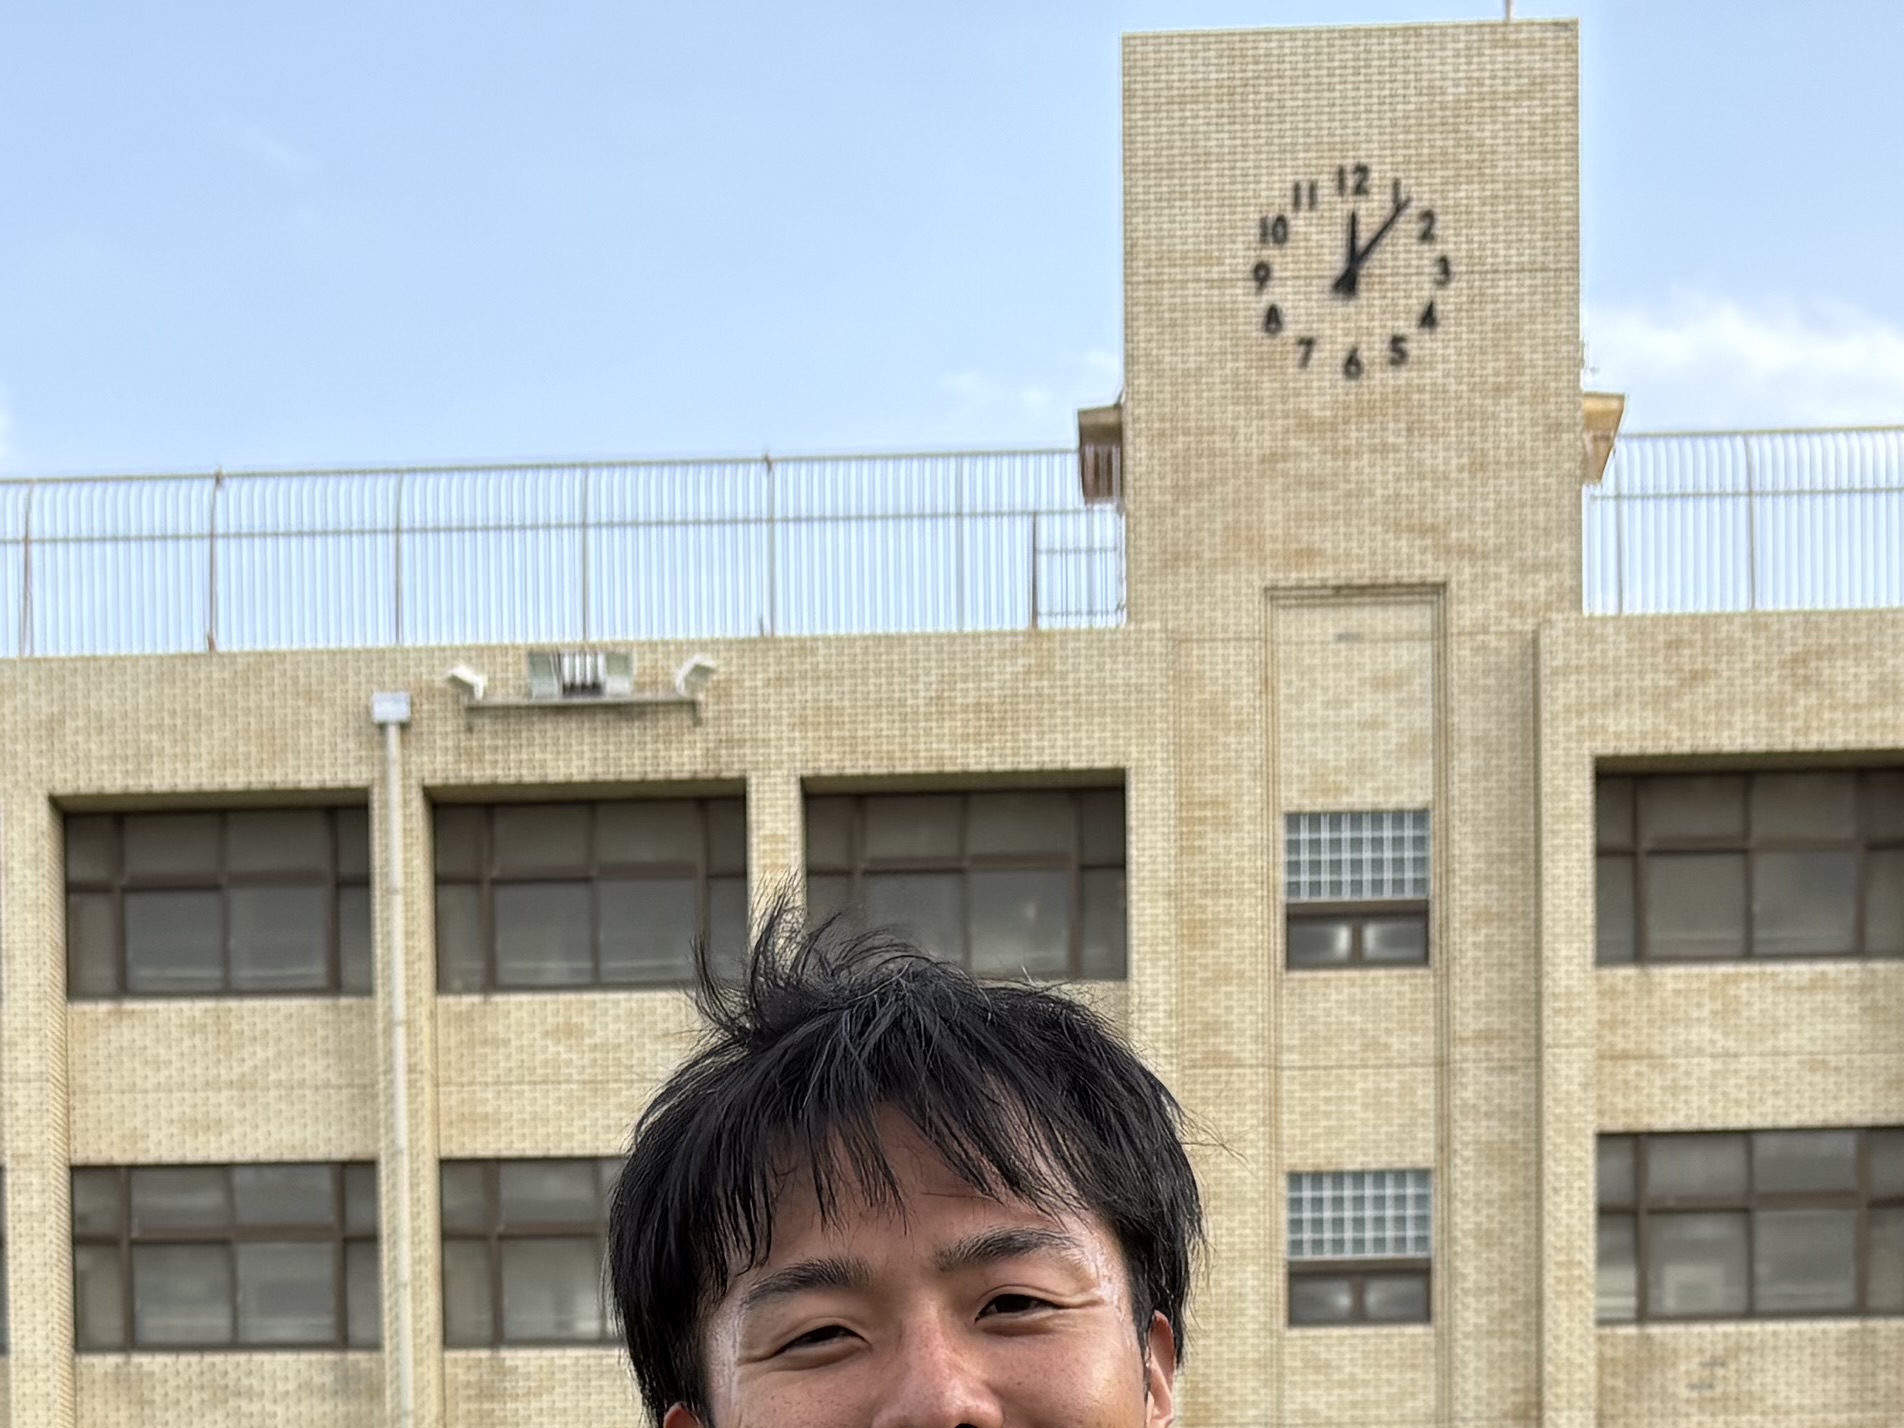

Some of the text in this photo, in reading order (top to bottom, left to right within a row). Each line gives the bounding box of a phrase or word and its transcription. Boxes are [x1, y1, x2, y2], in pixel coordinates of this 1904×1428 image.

[1293, 180, 1317, 212] 11
[1336, 162, 1370, 197] 12
[1259, 214, 1289, 246] 10
[1418, 209, 1436, 243] 2
[1253, 261, 1272, 297] 9
[1434, 254, 1452, 288] 3
[1263, 303, 1283, 336] 8
[1418, 299, 1438, 331] 4
[1297, 336, 1316, 370] 7
[1343, 347, 1364, 381] 6
[1389, 333, 1409, 367] 5
